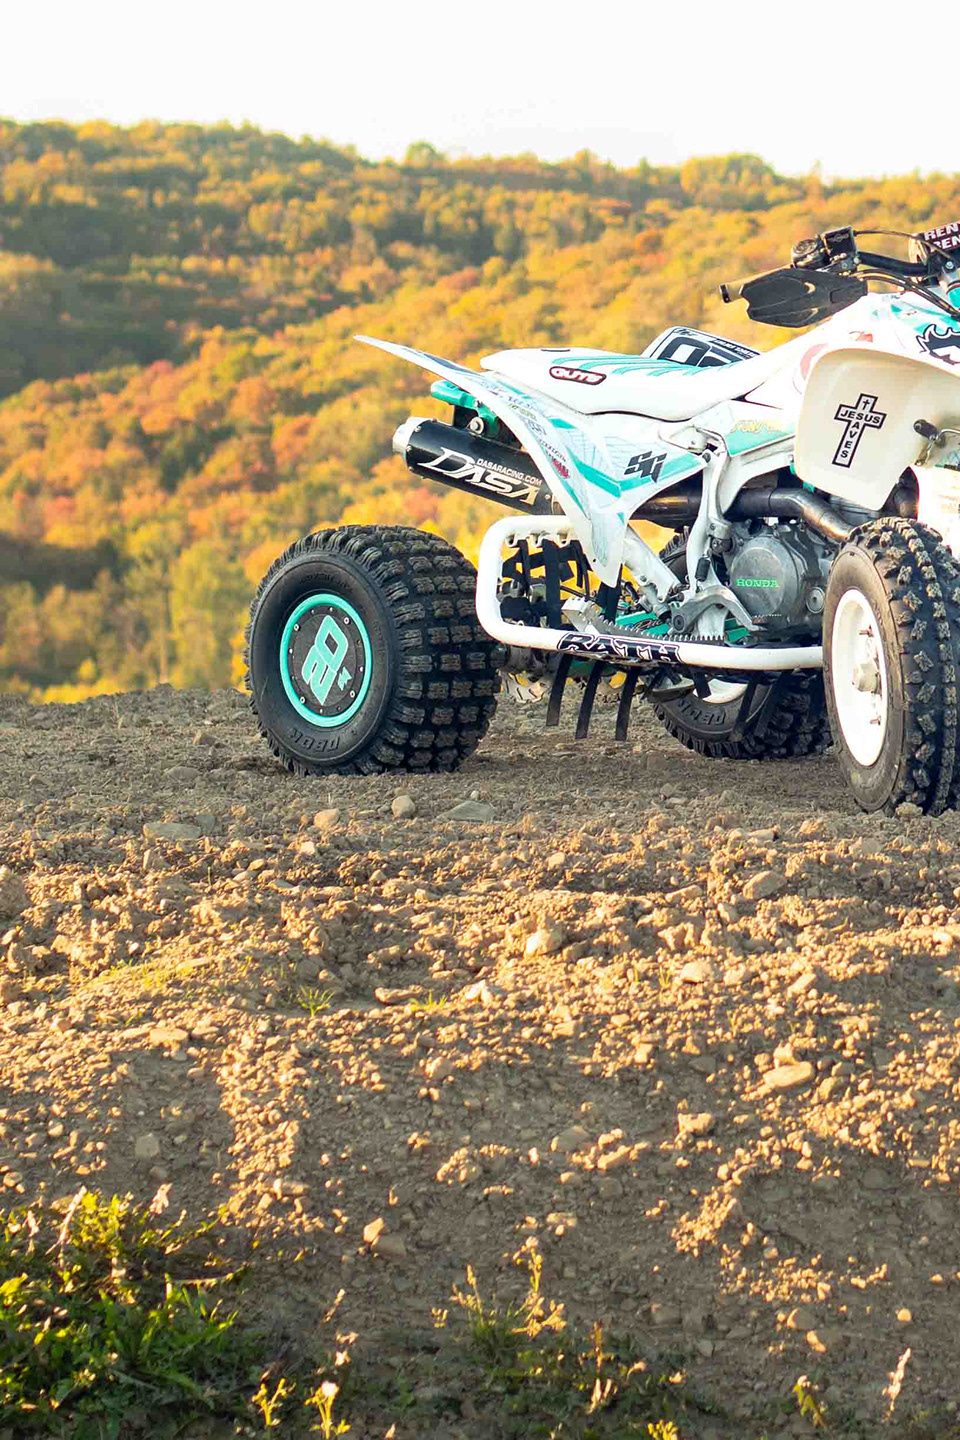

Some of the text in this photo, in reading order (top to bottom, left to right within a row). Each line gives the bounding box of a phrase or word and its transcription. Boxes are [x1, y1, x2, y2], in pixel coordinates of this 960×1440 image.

[840, 410, 881, 425] JESUS
[417, 446, 541, 506] DASA
[476, 458, 543, 487] DASARACING.COM
[736, 578, 780, 588] HONDA
[301, 614, 348, 706] 20
[557, 632, 684, 664] RATH
